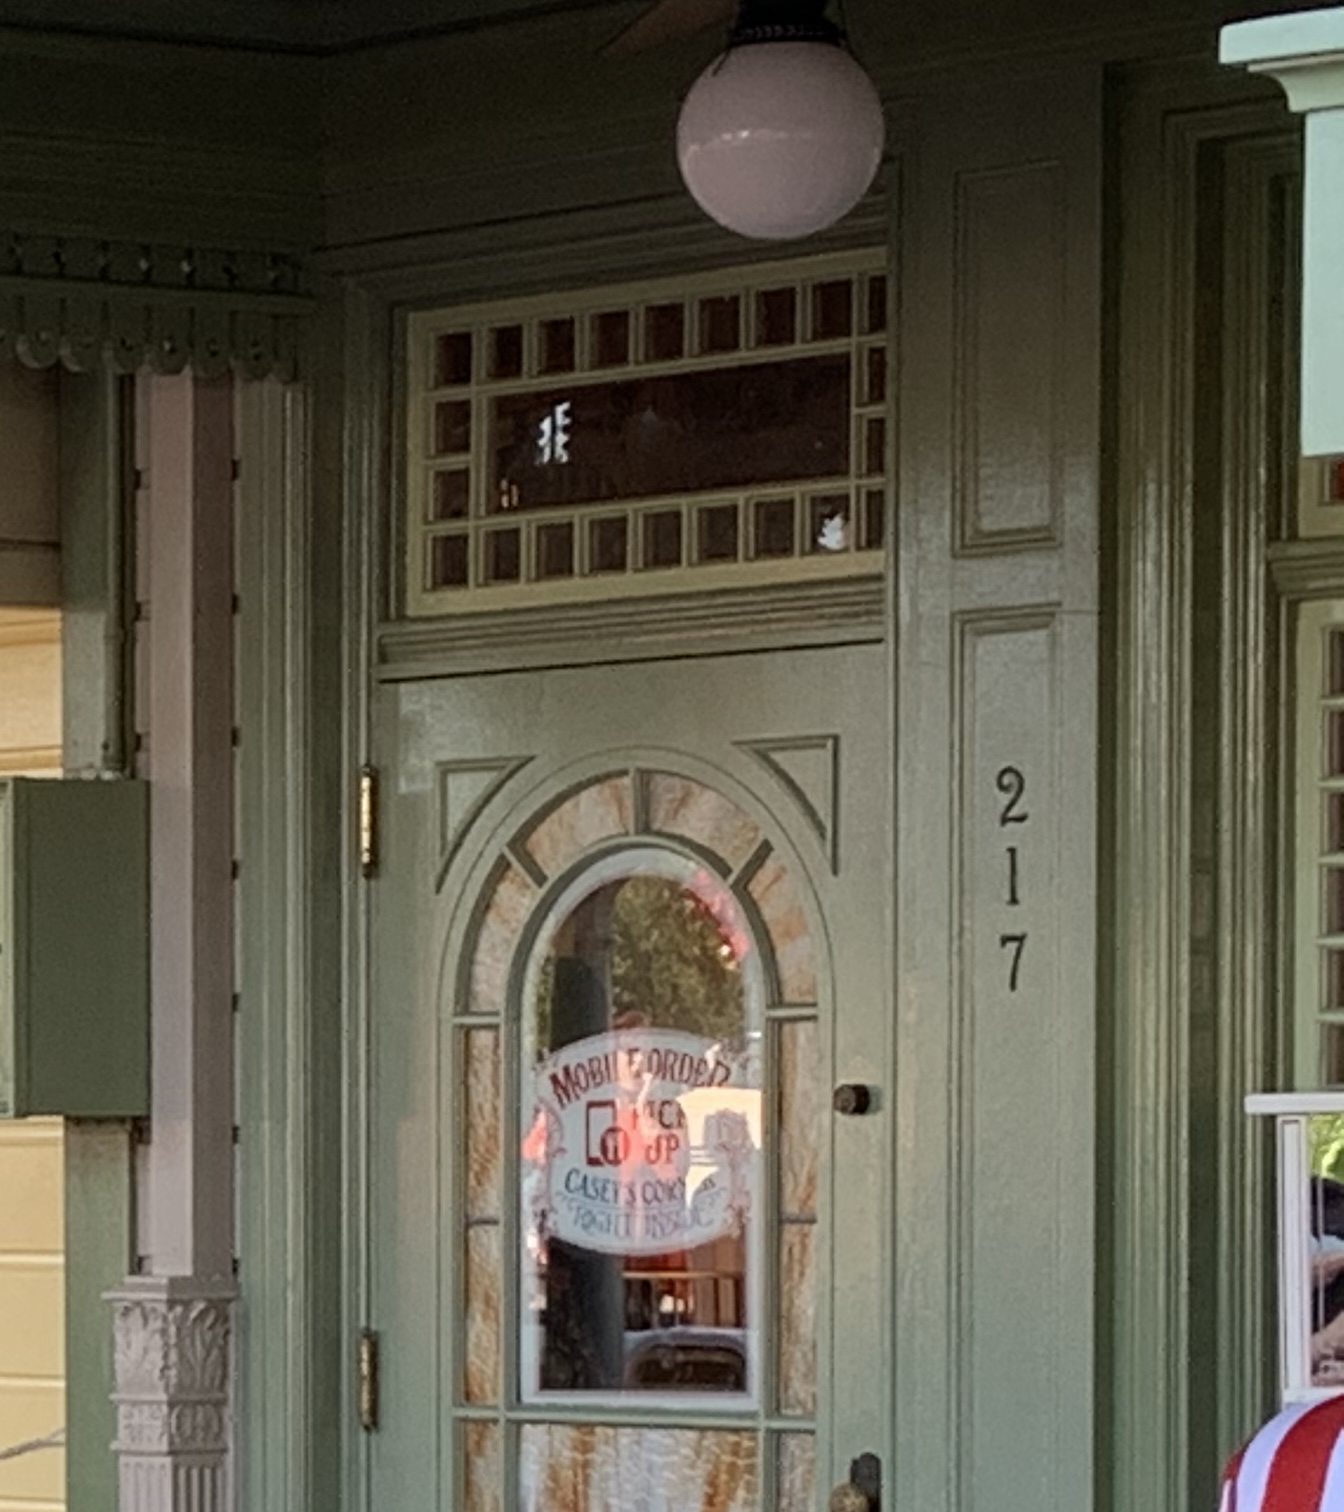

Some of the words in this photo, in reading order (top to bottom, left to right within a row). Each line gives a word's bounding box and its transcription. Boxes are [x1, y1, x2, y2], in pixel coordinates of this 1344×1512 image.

[996, 765, 1029, 992] 217
[549, 1048, 641, 1110] MOBILE
[647, 1048, 731, 1087] ORDER
[565, 1167, 636, 1206] CASEYS
[641, 1176, 716, 1206] CORNR
